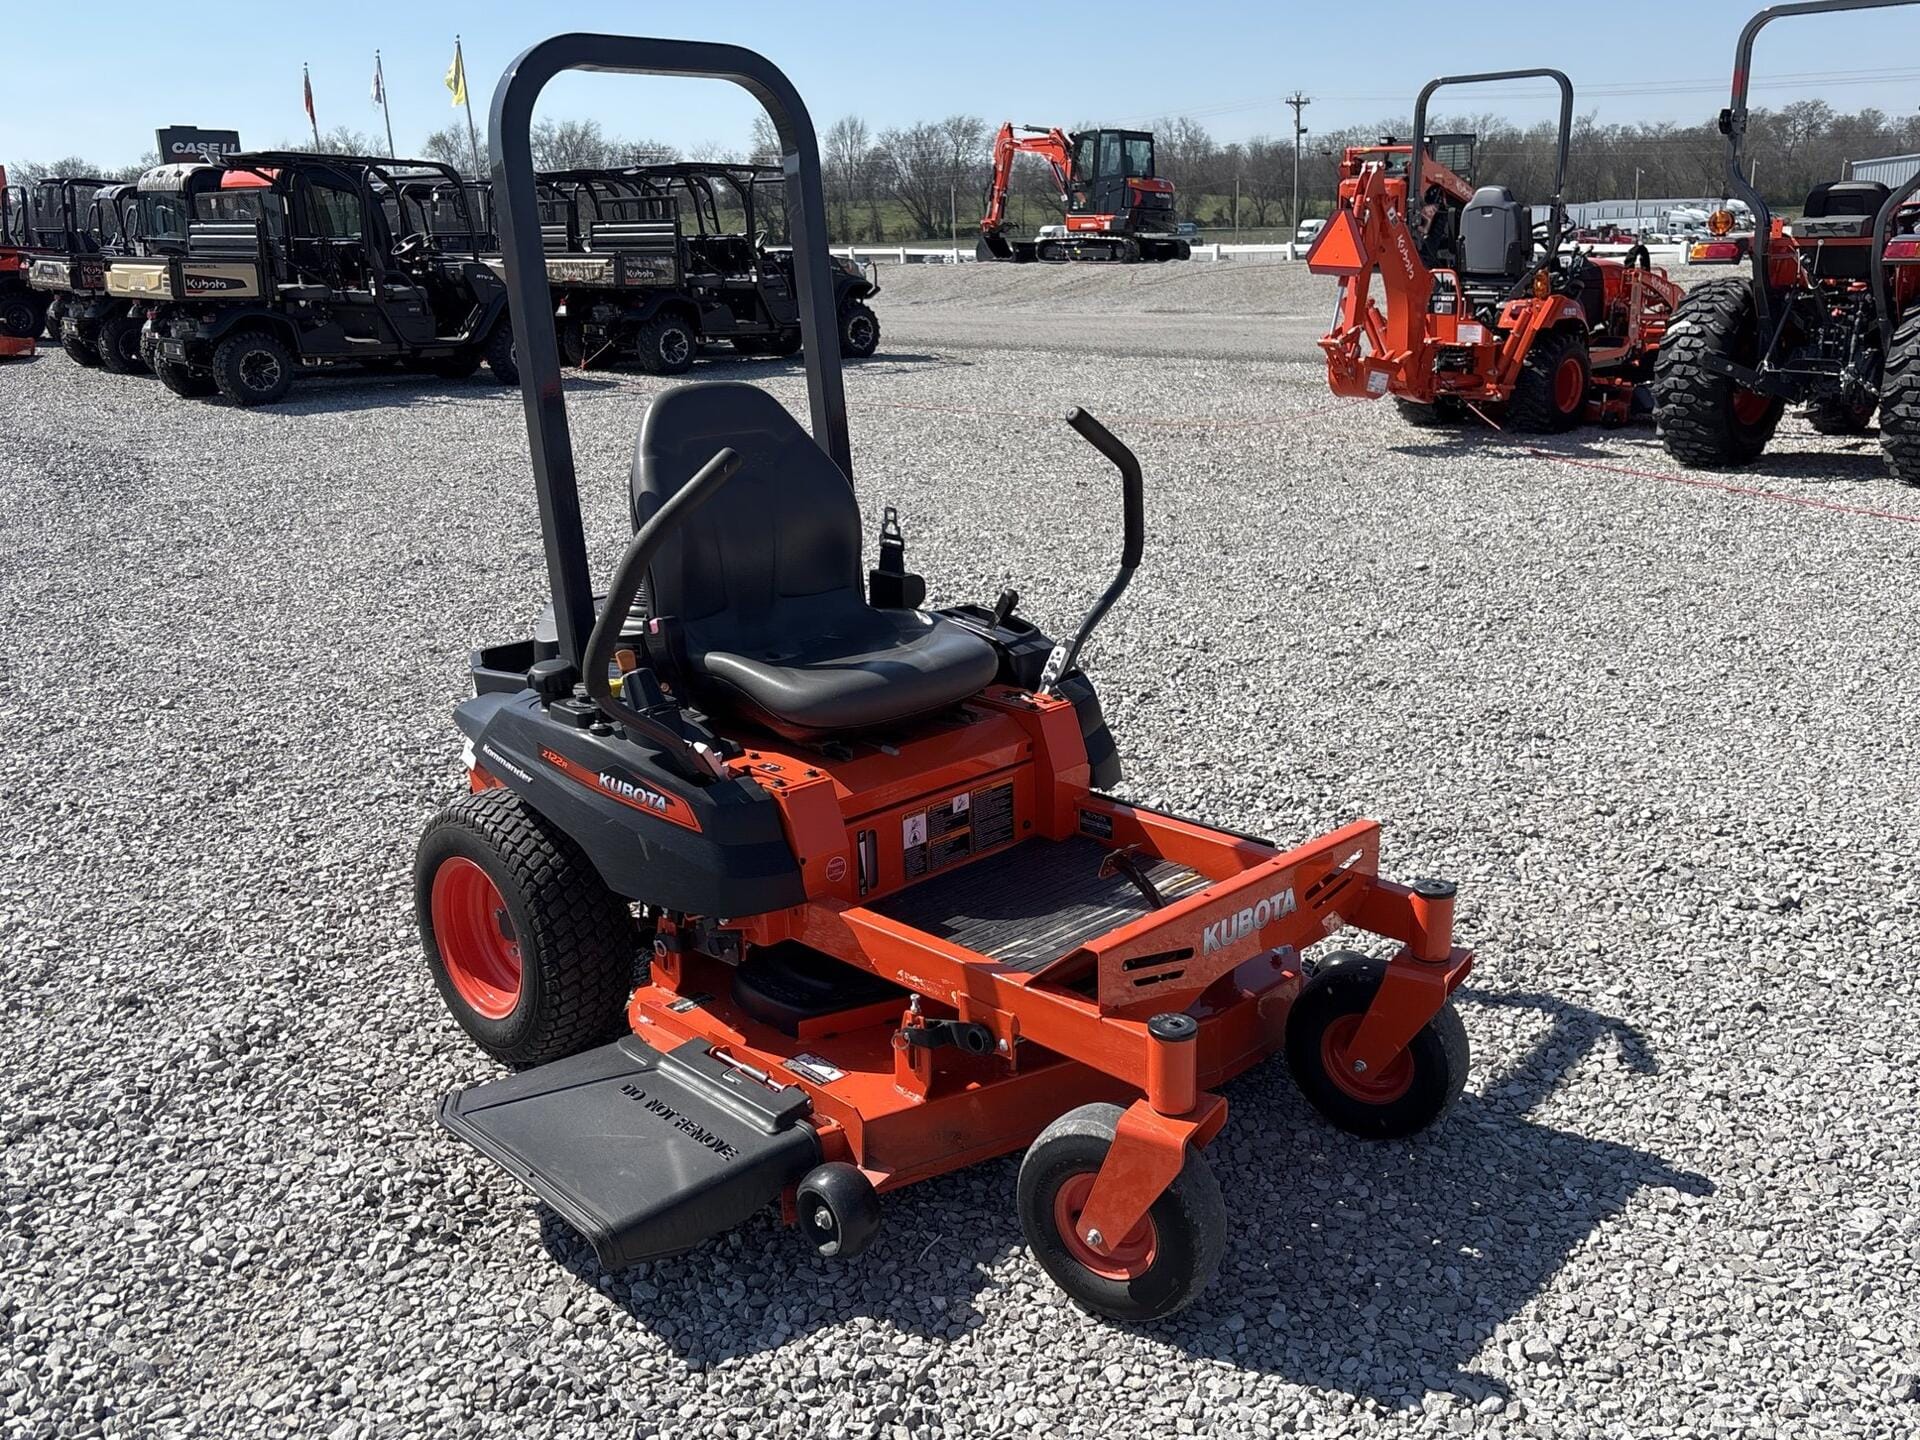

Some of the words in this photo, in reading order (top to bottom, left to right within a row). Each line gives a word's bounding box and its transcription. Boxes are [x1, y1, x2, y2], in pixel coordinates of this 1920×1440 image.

[171, 142, 220, 154] CASE
[626, 270, 655, 278] Kubota
[1397, 234, 1415, 280] Kubota
[185, 278, 228, 291] Kubota
[482, 743, 535, 784] Kommander
[598, 772, 668, 814] KUBOTA
[1203, 887, 1298, 957] KUBOTA
[619, 1083, 647, 1101] DO
[645, 1098, 680, 1121] NOT
[673, 1116, 740, 1162] REMOVE
